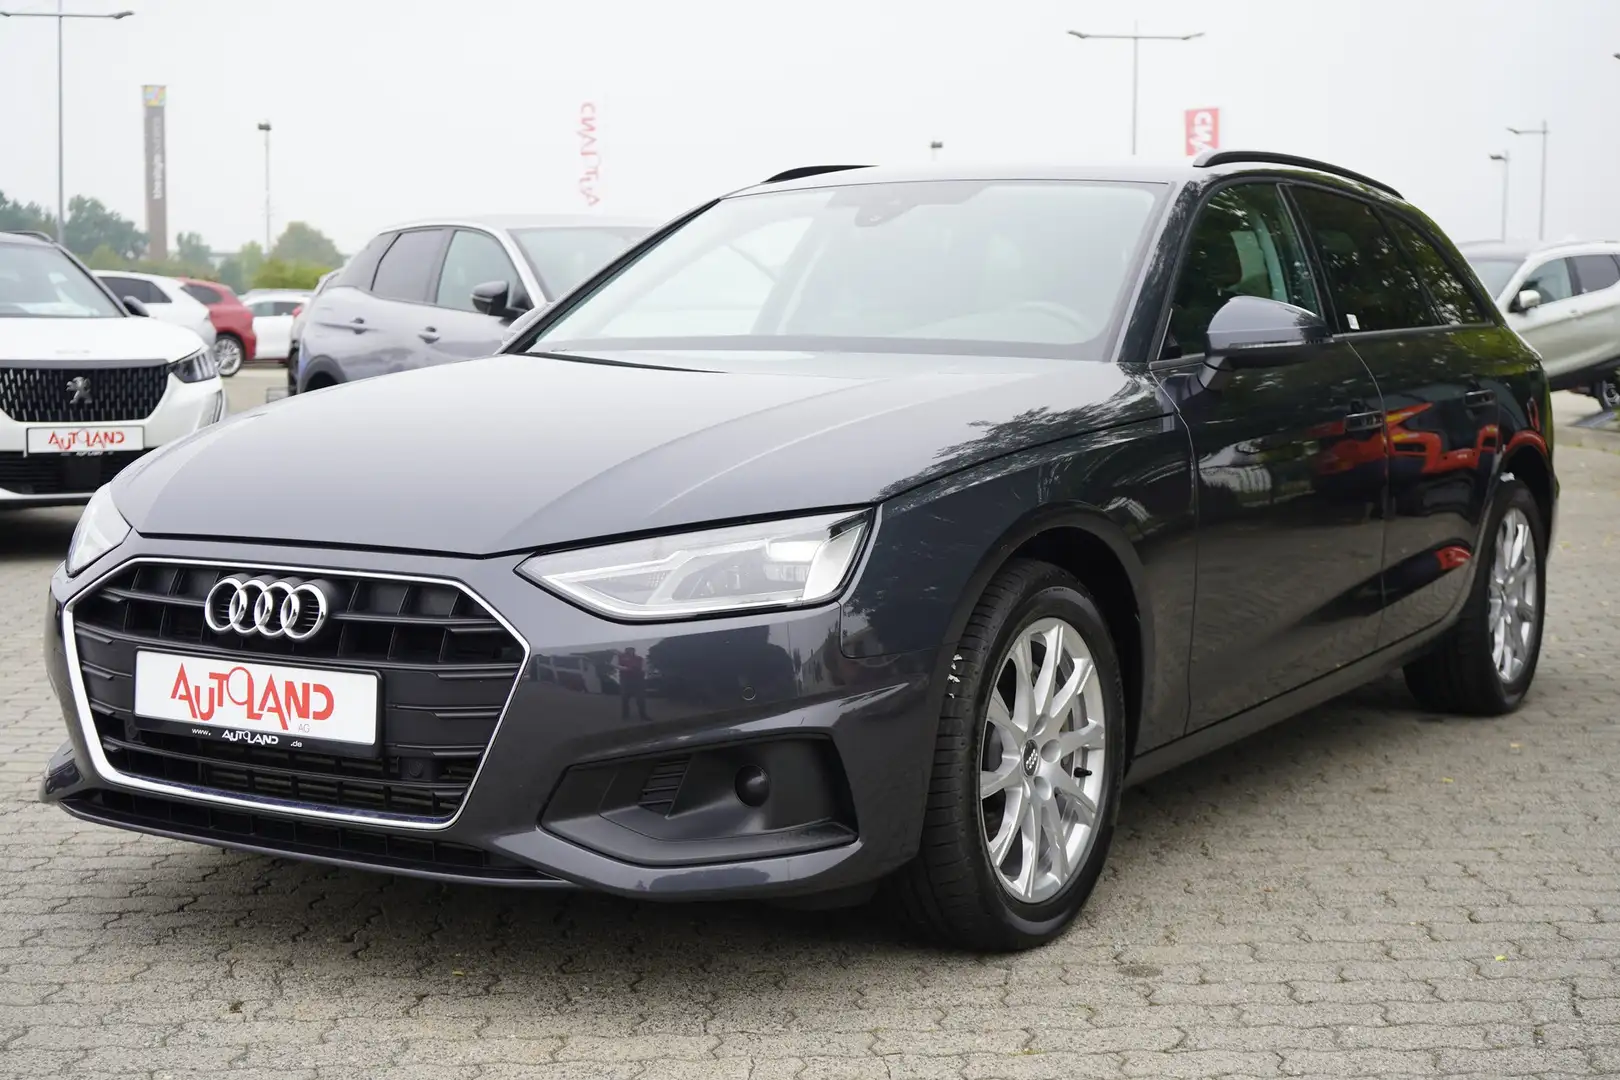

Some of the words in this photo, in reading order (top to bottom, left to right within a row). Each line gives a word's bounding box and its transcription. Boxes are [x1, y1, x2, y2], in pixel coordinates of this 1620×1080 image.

[48, 428, 125, 450] AUTOLAND
[170, 662, 335, 731] AUTOLAND
[191, 727, 212, 737] www.
[221, 729, 279, 746] AUTOLAND
[290, 739, 303, 748] .de
[297, 723, 311, 734] AG
